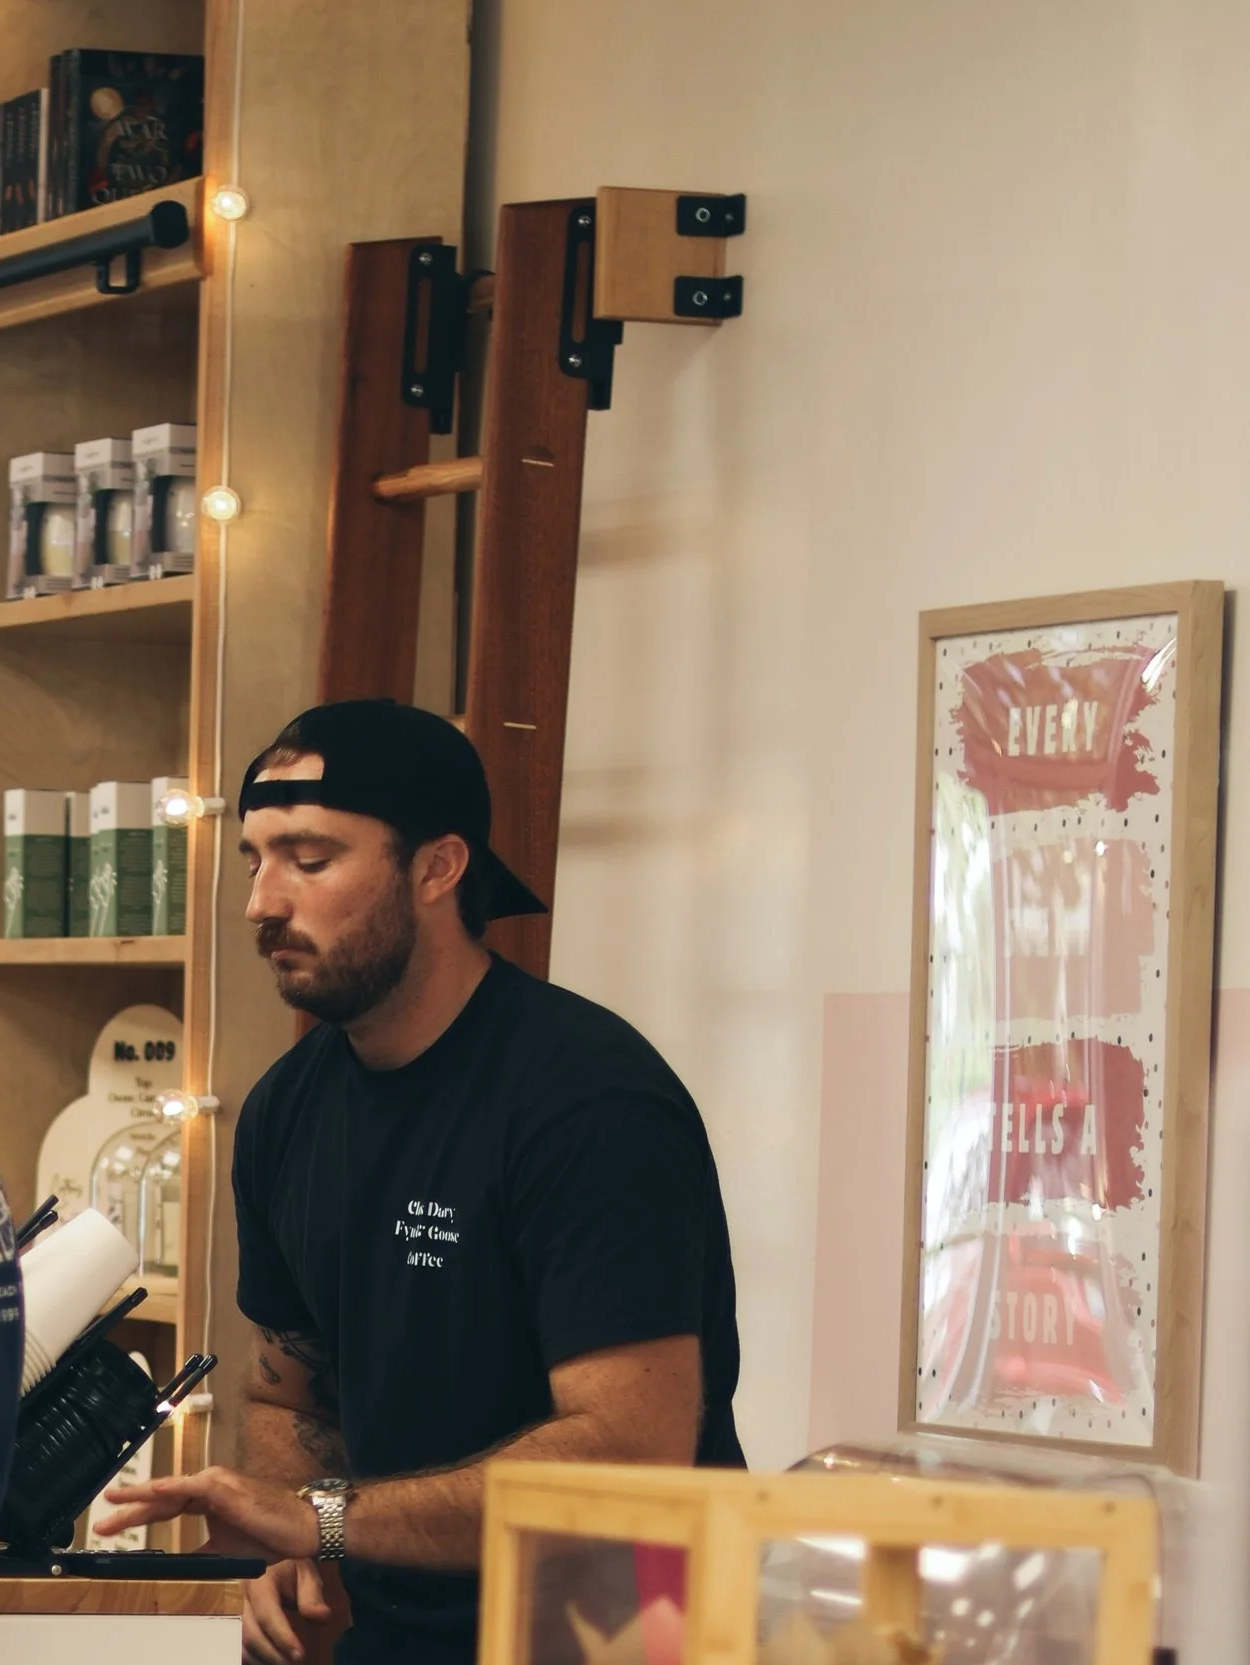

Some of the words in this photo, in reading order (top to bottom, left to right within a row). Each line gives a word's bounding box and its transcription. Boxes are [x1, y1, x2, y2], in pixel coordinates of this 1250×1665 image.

[1008, 700, 1099, 757] EVERY
[144, 1040, 175, 1062] 009
[1081, 1104, 1097, 1155] A
[428, 1226, 460, 1243] Goose
[990, 1292, 1075, 1345] STORY
